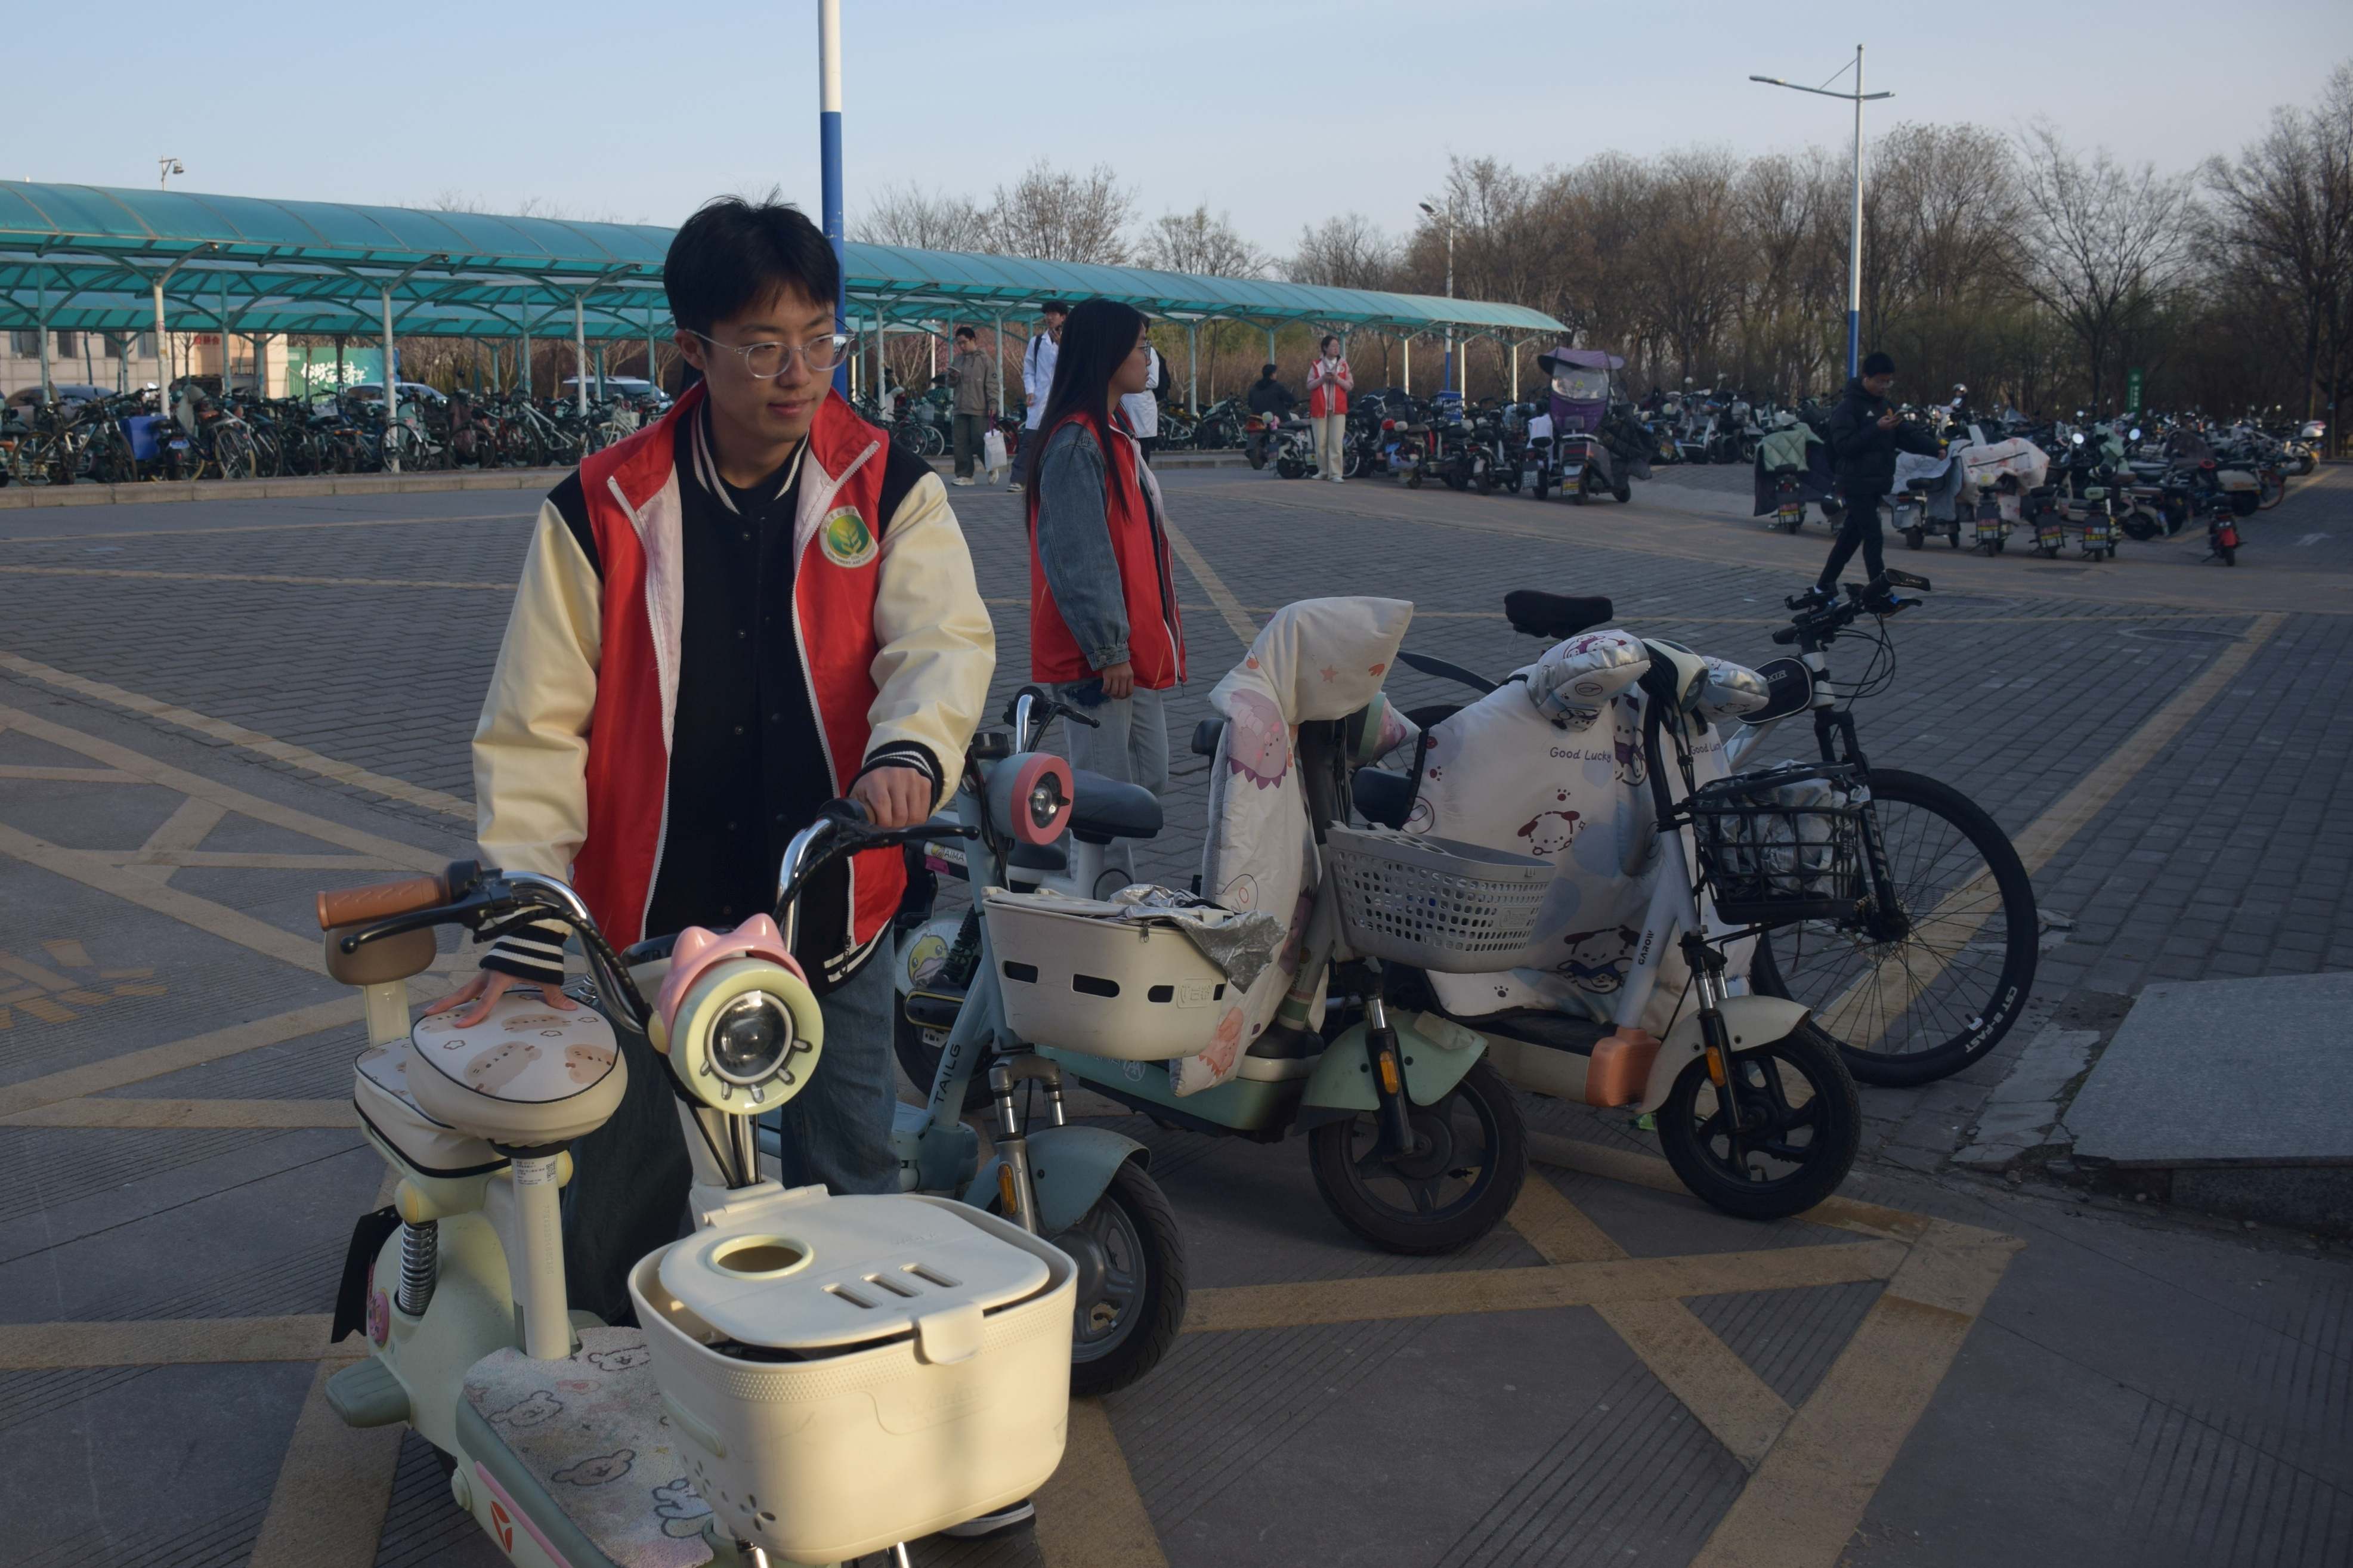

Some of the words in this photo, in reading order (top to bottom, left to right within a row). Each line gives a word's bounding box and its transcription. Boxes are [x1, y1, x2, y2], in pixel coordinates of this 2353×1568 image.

[1550, 747, 1581, 759] Good
[1584, 750, 1611, 763] Lucky
[1690, 743, 1708, 754] Good
[944, 850, 964, 861] AIMA
[2002, 986, 2018, 1012] CST
[933, 1044, 961, 1105] TAILG
